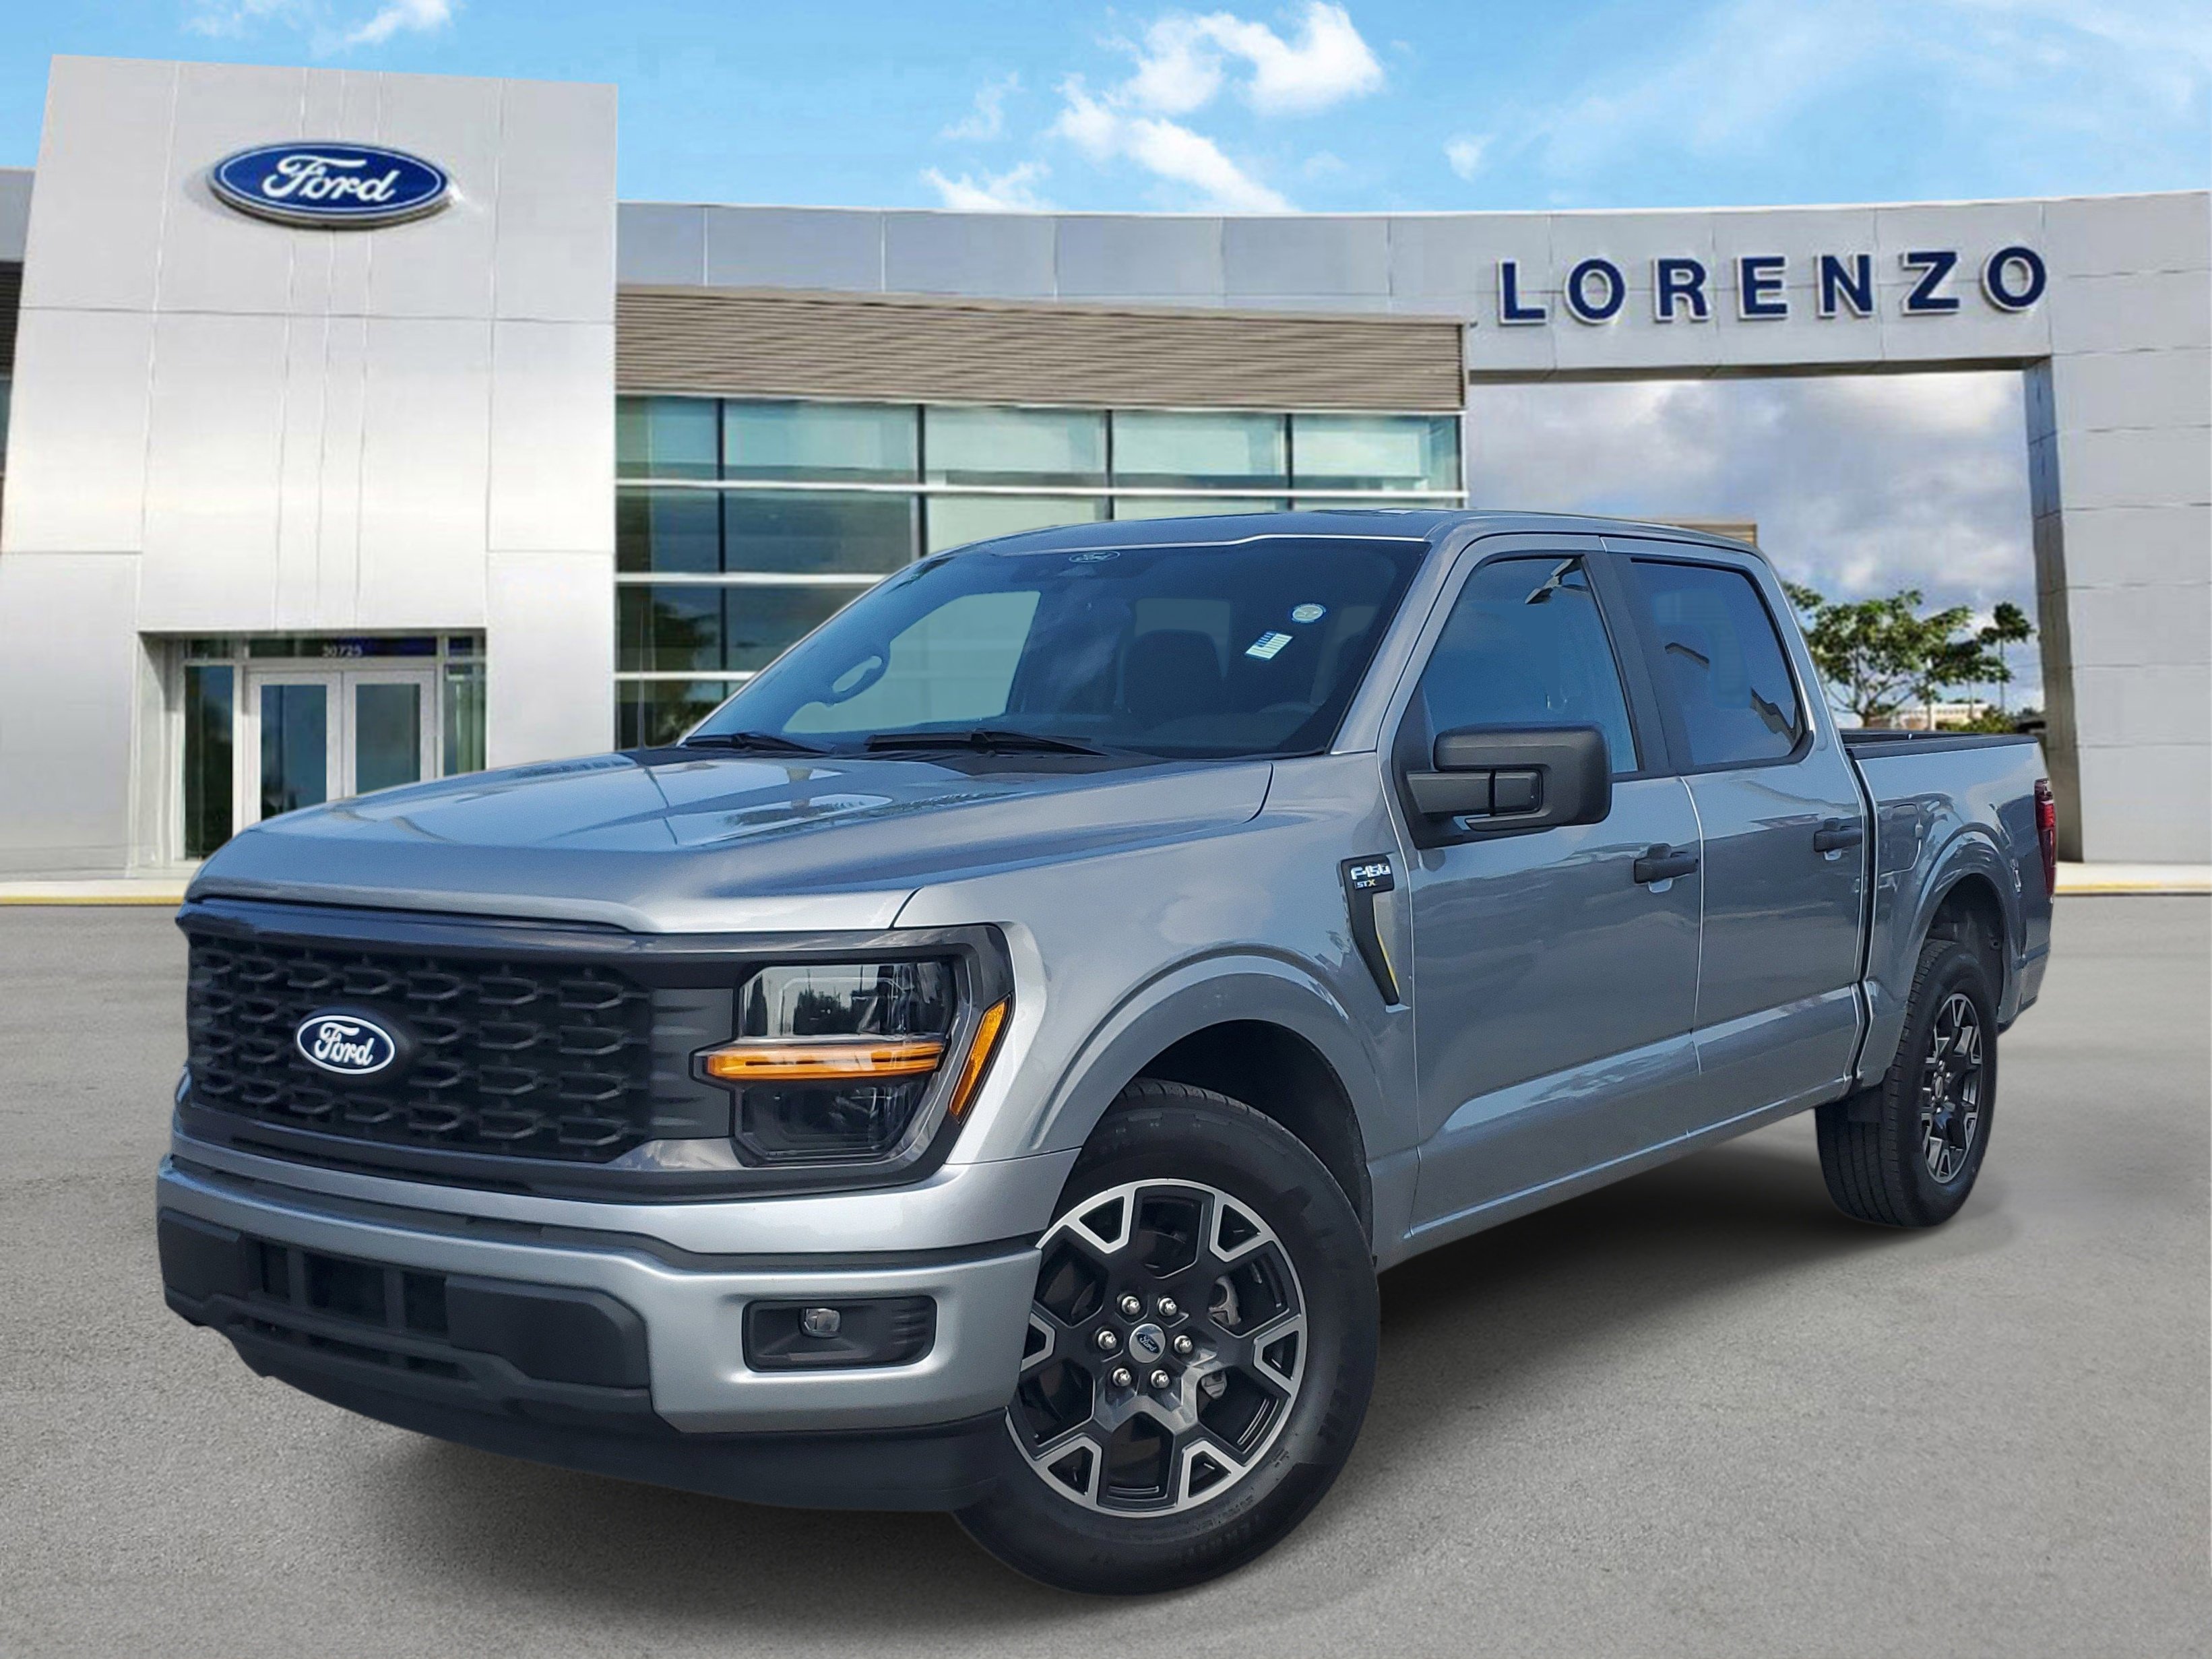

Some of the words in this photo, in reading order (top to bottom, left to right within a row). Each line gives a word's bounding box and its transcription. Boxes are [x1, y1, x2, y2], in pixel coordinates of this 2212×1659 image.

[262, 154, 401, 201] Ford
[1497, 246, 2047, 325] LORENZO
[1350, 863, 1391, 880] F-150
[1357, 879, 1376, 888] STX
[314, 1022, 375, 1066] Ford
[1139, 1336, 1158, 1351] Ford
